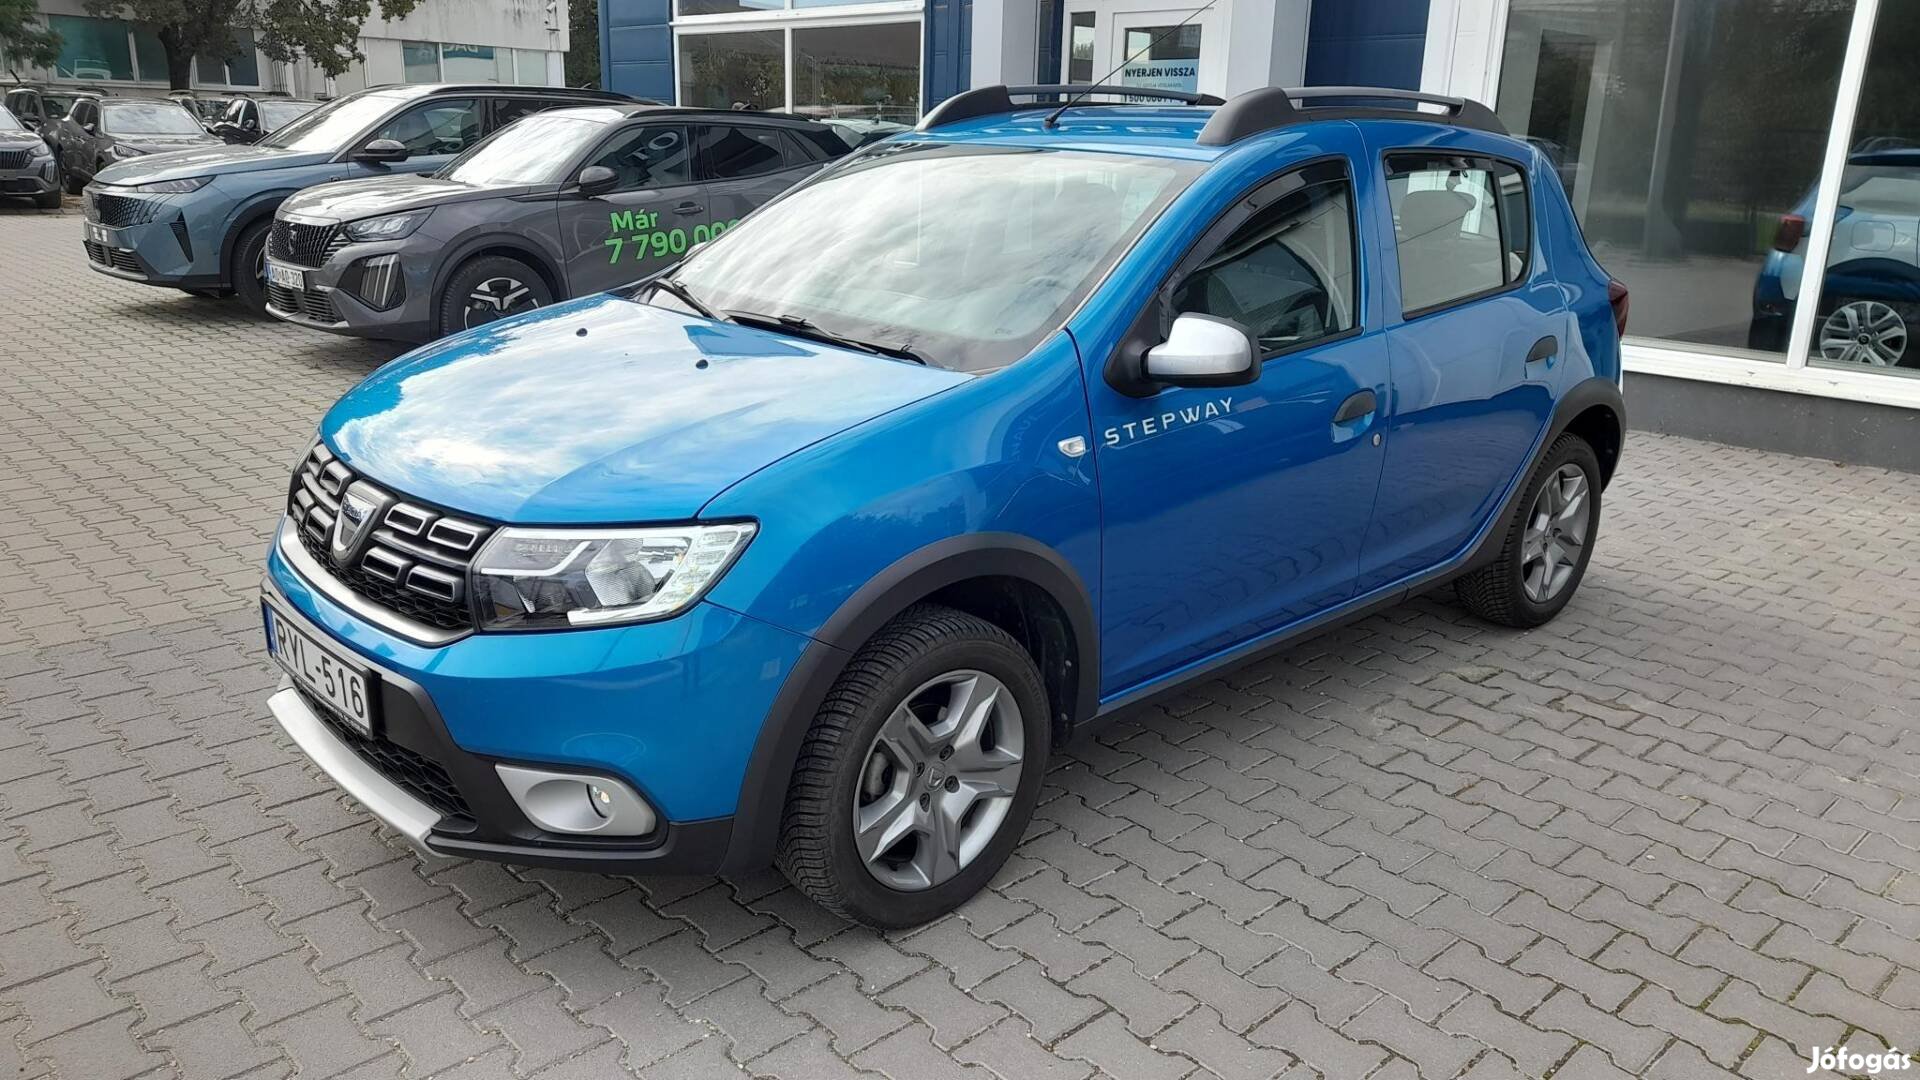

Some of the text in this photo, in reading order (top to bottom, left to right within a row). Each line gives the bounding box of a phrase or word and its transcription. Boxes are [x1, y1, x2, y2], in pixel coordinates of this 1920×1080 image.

[1125, 67, 1196, 78] NYERJEN VISSZA
[604, 219, 739, 264] 7 790 00
[610, 208, 659, 233] Már
[1104, 397, 1233, 446] STEPWAY
[275, 618, 364, 719] RYL-516
